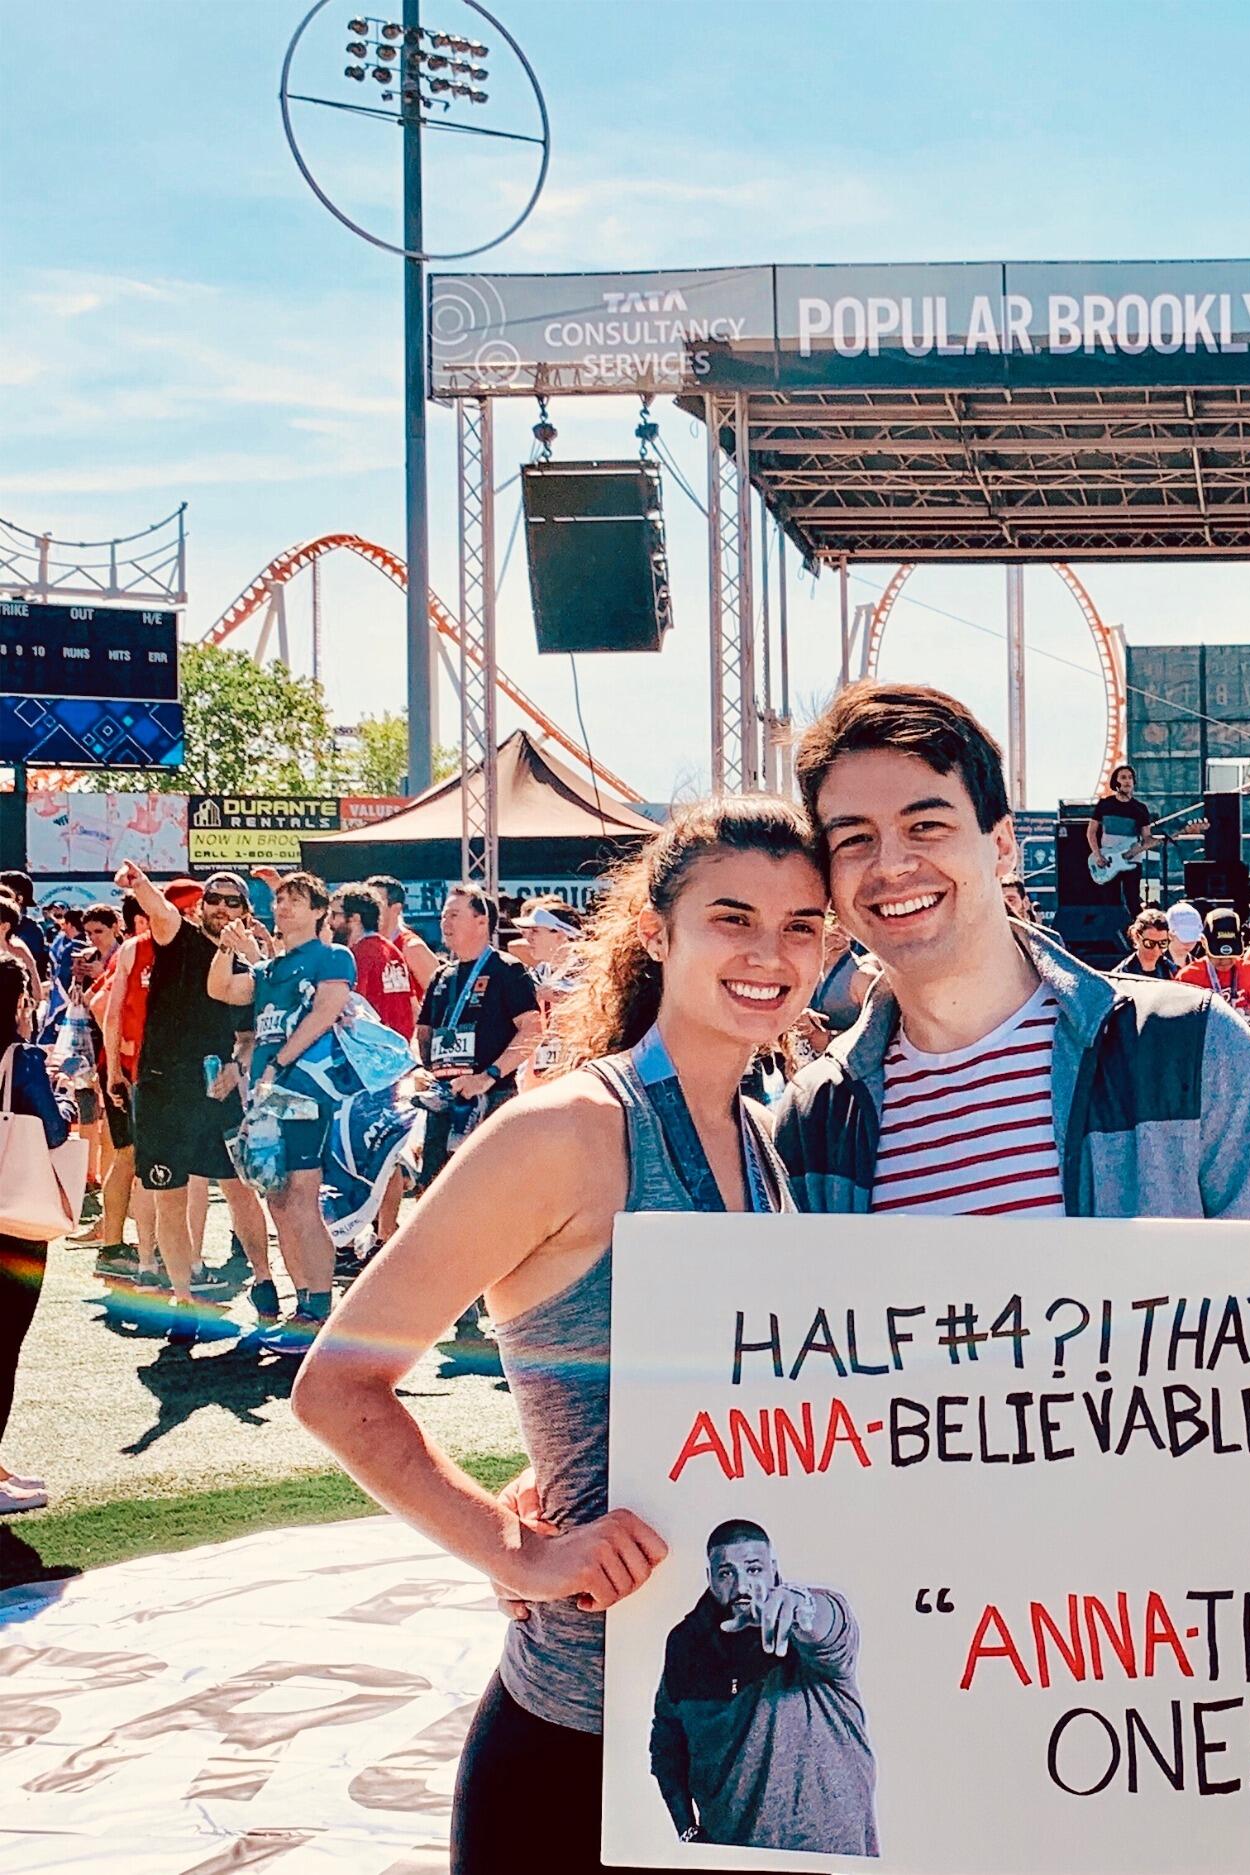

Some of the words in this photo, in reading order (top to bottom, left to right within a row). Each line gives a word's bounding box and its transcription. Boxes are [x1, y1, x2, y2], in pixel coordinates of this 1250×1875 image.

[603, 290, 687, 313] TATA
[544, 317, 746, 347] CONSULTANCY
[800, 294, 1034, 357] POPULAR
[583, 350, 711, 378] SERVICES
[70, 607, 95, 621] OUT
[142, 612, 162, 625] H/E
[32, 646, 45, 657] 10
[63, 647, 91, 660] RUNS
[109, 649, 131, 662] HITS
[148, 651, 168, 664] ERR
[223, 800, 338, 817] DURANTE
[231, 816, 331, 828] RENTALS
[194, 833, 230, 847] NOW
[236, 833, 255, 846] IN
[194, 850, 227, 858] CALL
[731, 1303, 927, 1385] HALF
